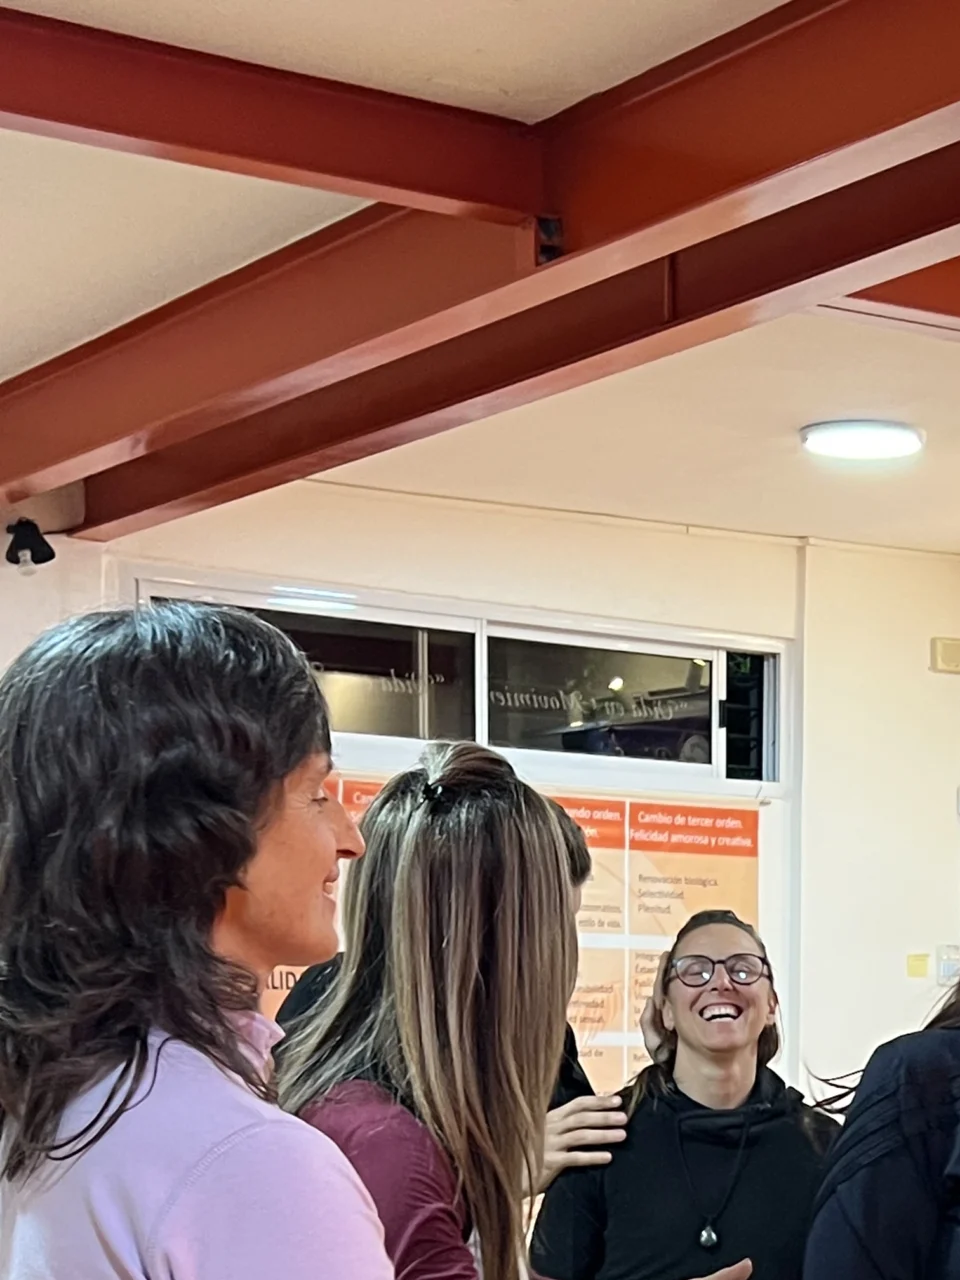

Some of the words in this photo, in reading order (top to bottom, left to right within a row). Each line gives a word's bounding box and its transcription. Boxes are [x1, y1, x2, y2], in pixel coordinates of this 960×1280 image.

[638, 811, 673, 825] Cambio
[674, 814, 686, 826] de
[687, 815, 714, 828] tercer
[715, 817, 744, 829] orden.
[629, 829, 669, 843] Felicidad
[670, 833, 709, 845] amorosa
[710, 836, 717, 848] y
[266, 970, 297, 990] LID
